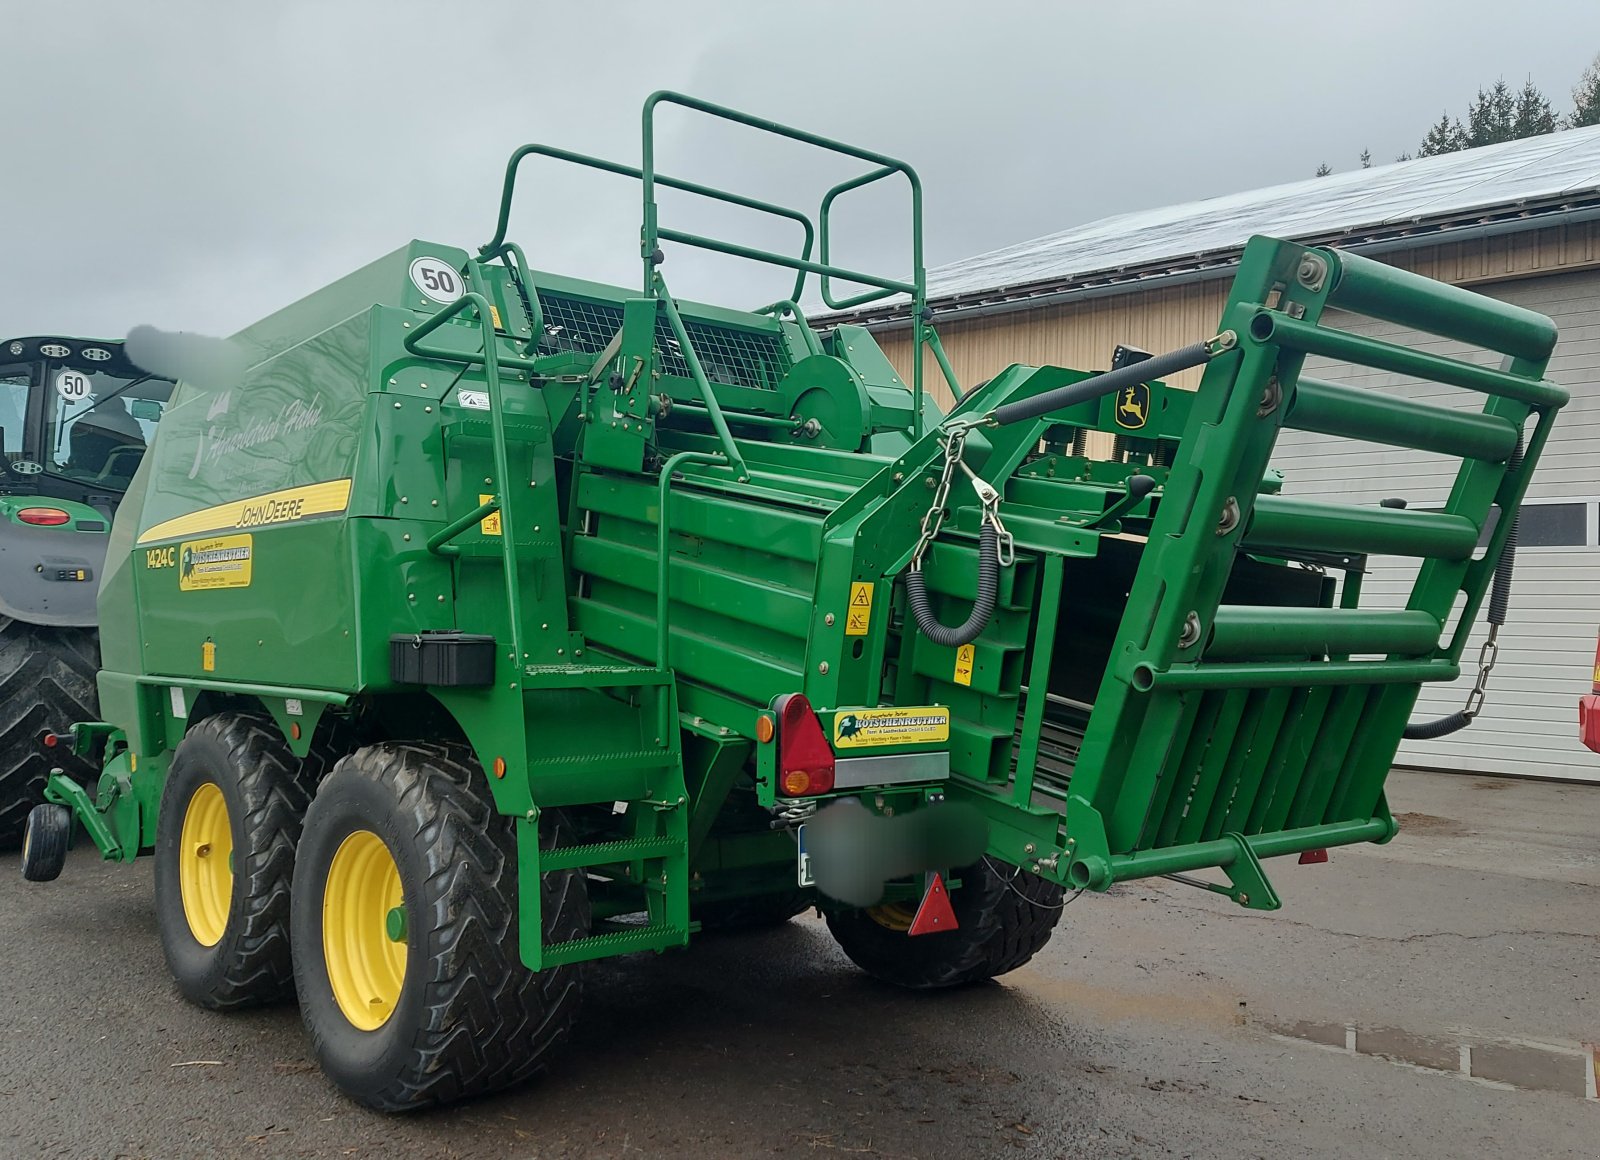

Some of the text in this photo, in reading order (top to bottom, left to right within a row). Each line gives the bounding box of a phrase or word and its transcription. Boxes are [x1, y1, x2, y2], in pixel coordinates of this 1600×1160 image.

[421, 267, 454, 294] 50
[64, 375, 84, 395] 50
[236, 499, 304, 526] JOHN DEERE
[146, 547, 175, 569] 1424C
[855, 716, 946, 729] KOTSCHENREUTHER
